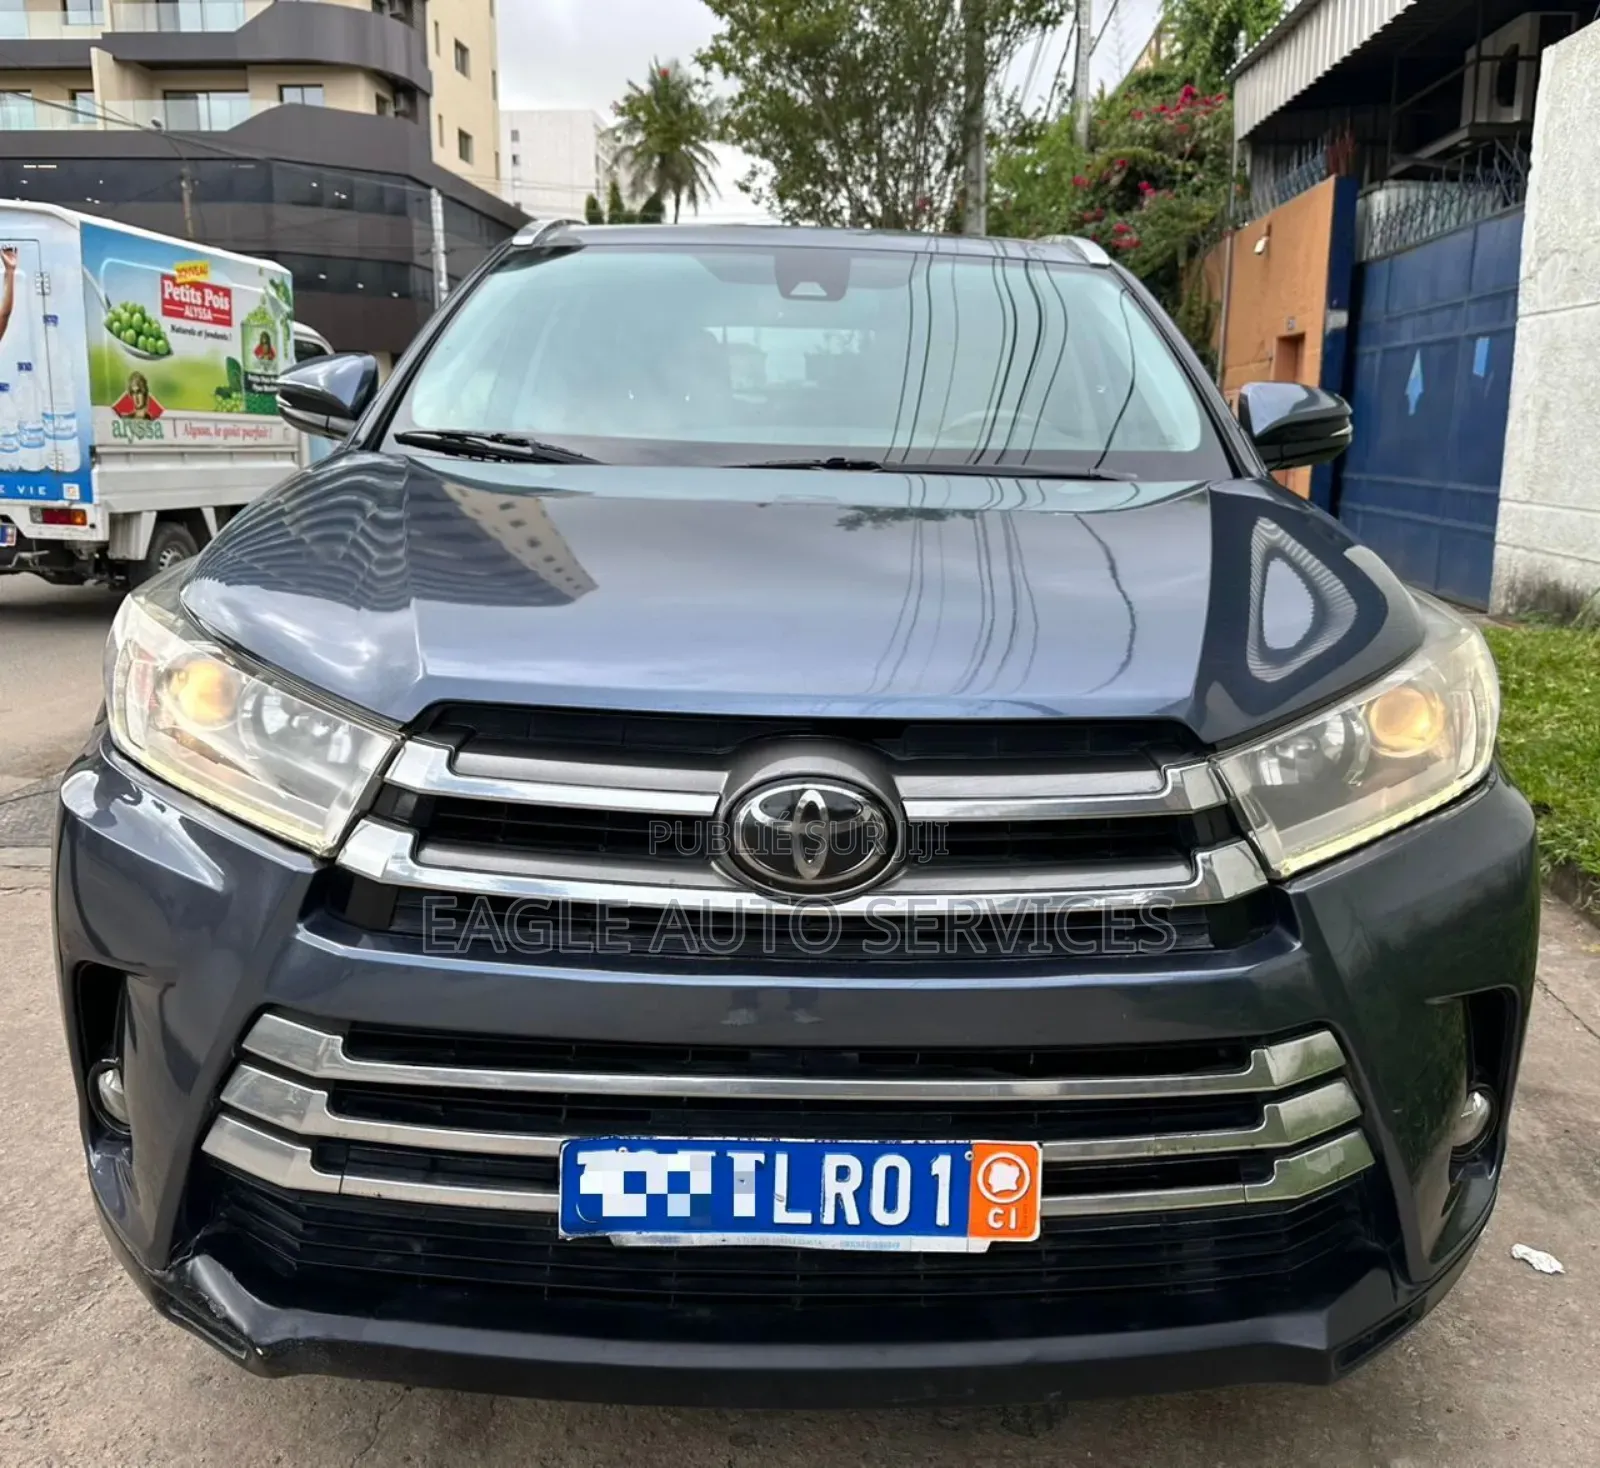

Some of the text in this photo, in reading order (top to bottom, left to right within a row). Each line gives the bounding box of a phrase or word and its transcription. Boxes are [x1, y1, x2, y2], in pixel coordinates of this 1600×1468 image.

[163, 279, 230, 311] Petits Pois
[184, 305, 213, 320] ALYSSA
[112, 418, 164, 444] alyssa
[16, 485, 47, 496] VIE
[987, 1207, 1017, 1229] CI
